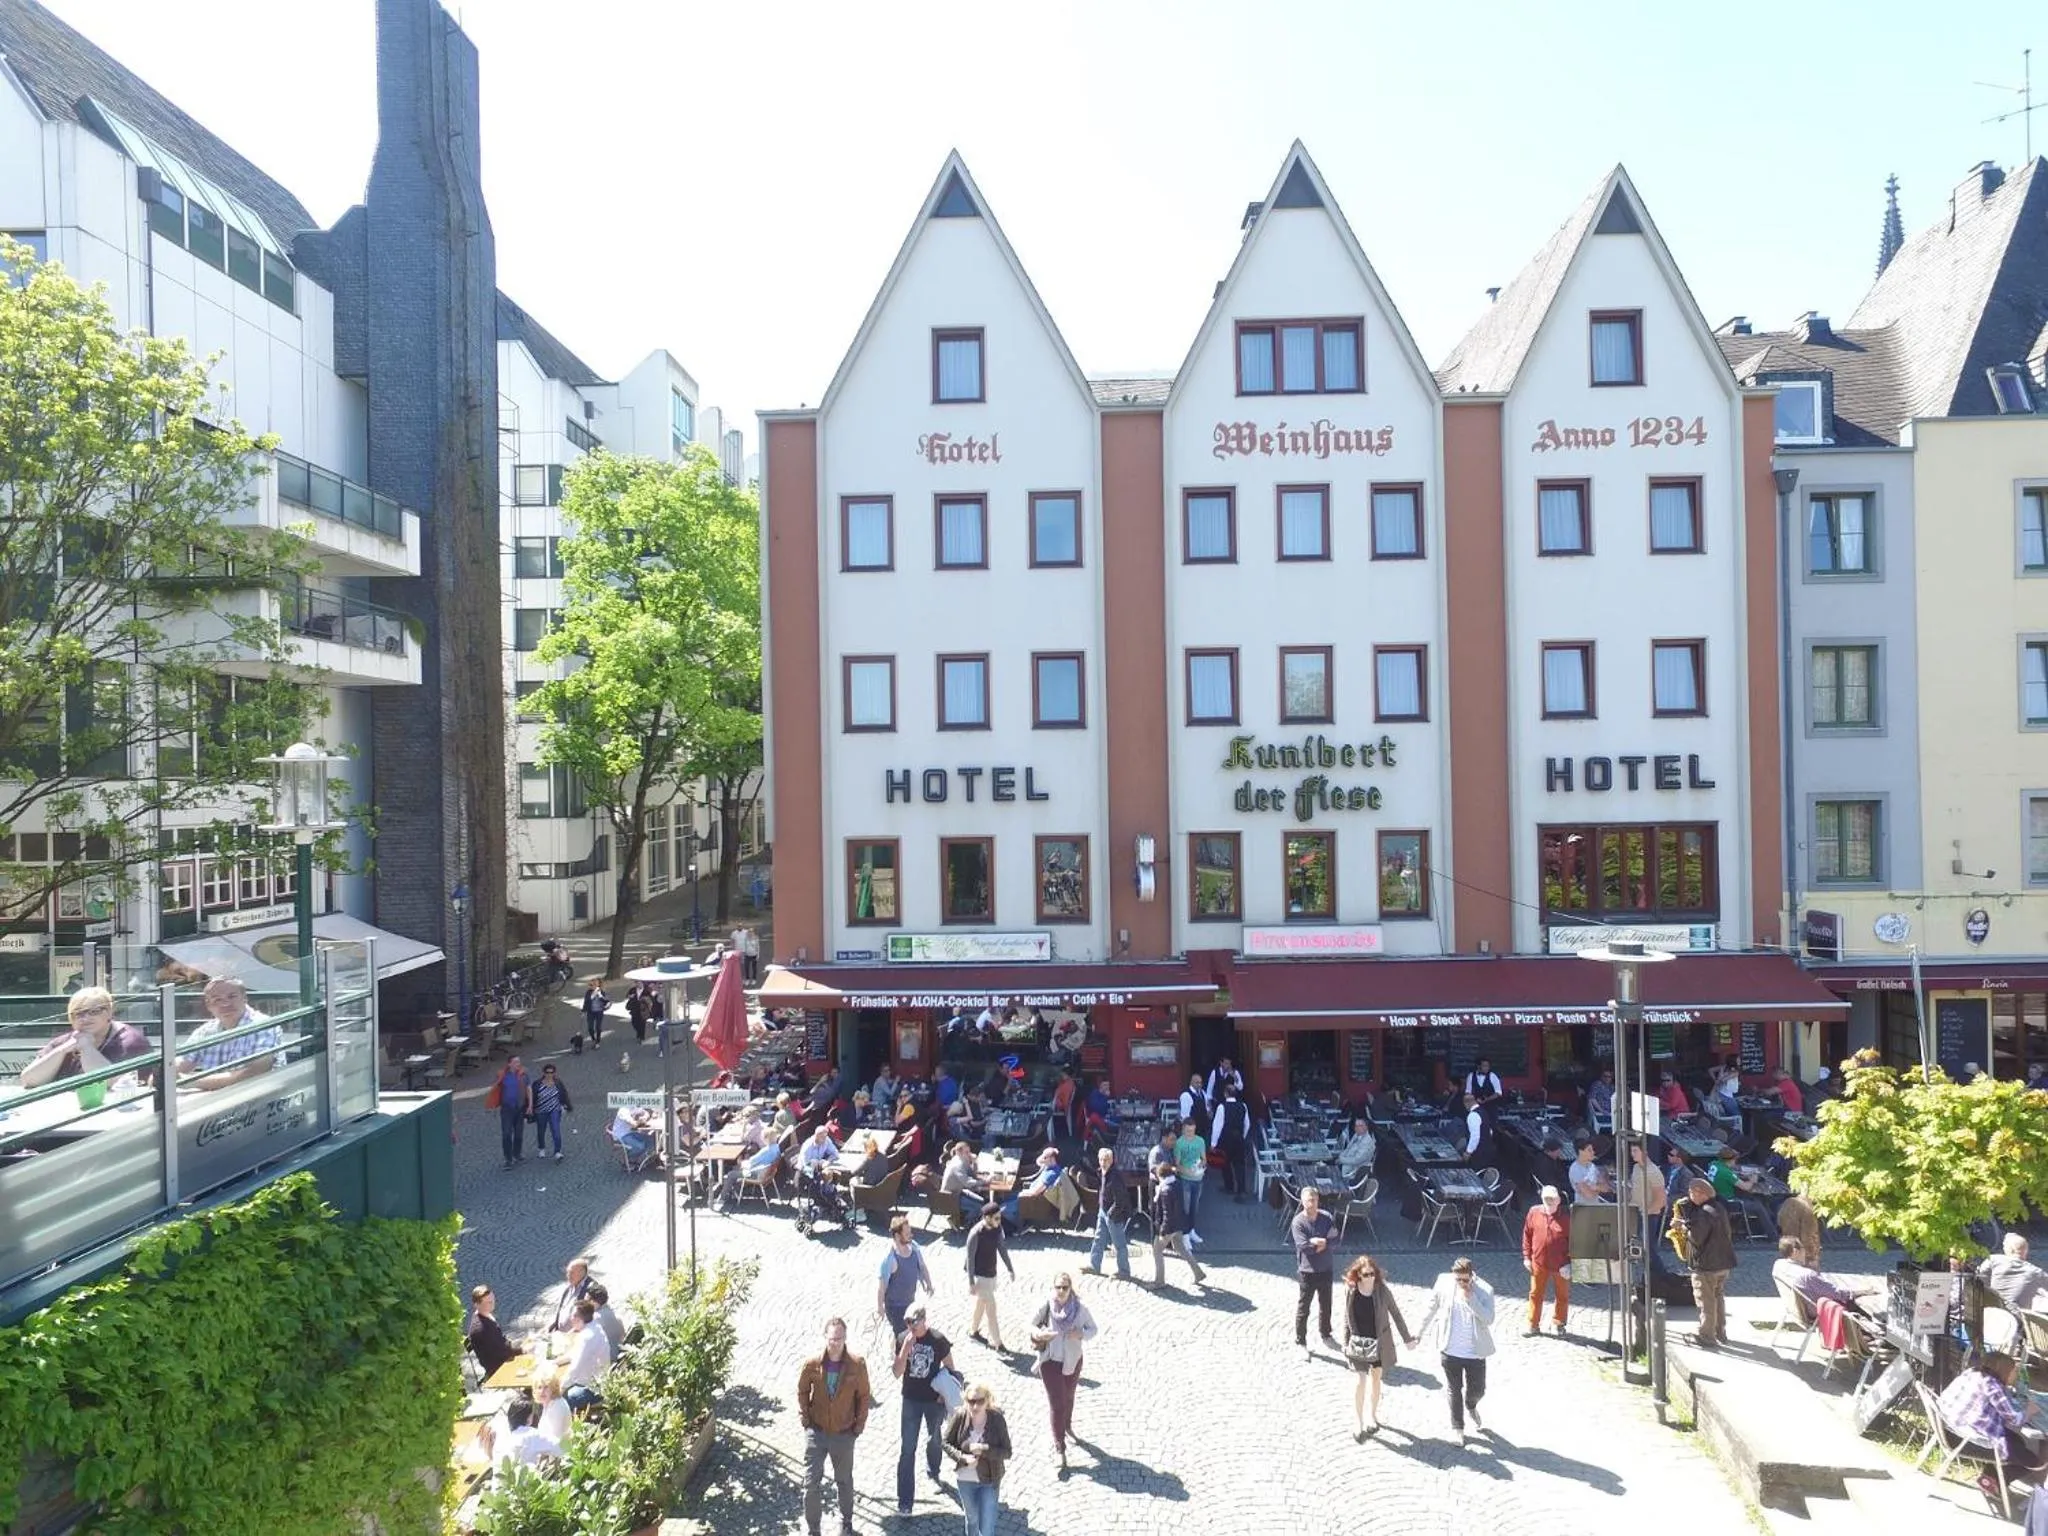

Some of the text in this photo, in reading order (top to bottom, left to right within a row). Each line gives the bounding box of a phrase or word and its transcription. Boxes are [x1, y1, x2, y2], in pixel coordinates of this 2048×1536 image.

[916, 431, 1003, 465] Hotel
[1212, 418, 1395, 461] Weinhaus
[1531, 415, 1708, 452] Anno 1234
[1221, 734, 1398, 769] Kunibert
[885, 766, 1050, 804] HOTEL
[1545, 753, 1716, 793] HOTEL
[1234, 780, 1287, 813] der
[851, 993, 1124, 1008] Frühstück ALOHA-Cocktail Bar Kuchen Café Eis
[1390, 1015, 1418, 1026] Haxe
[1430, 1014, 1462, 1026] Steak
[1473, 1014, 1502, 1025] Fisch
[1515, 1013, 1544, 1024] Pizza
[1556, 1012, 1588, 1024] Pasta
